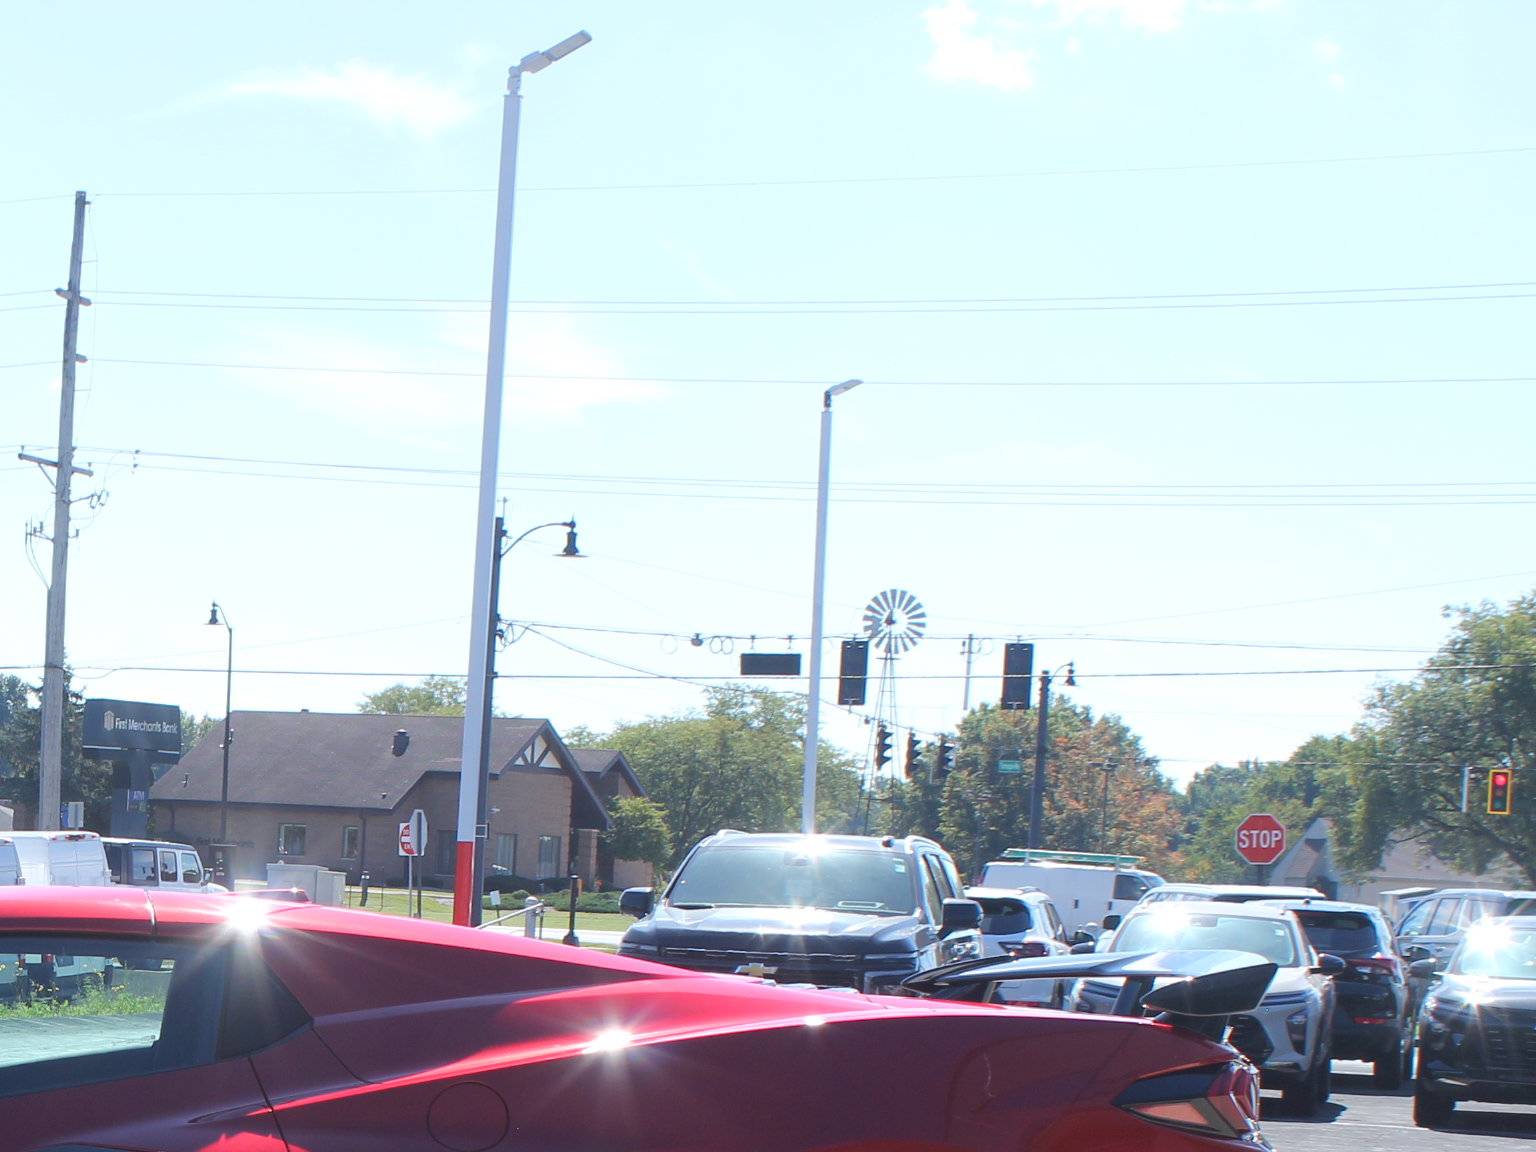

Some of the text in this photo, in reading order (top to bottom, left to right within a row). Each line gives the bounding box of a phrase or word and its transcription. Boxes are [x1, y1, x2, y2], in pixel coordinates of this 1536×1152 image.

[115, 717, 177, 734] First Merchants Bank
[1239, 830, 1282, 849] STOP
